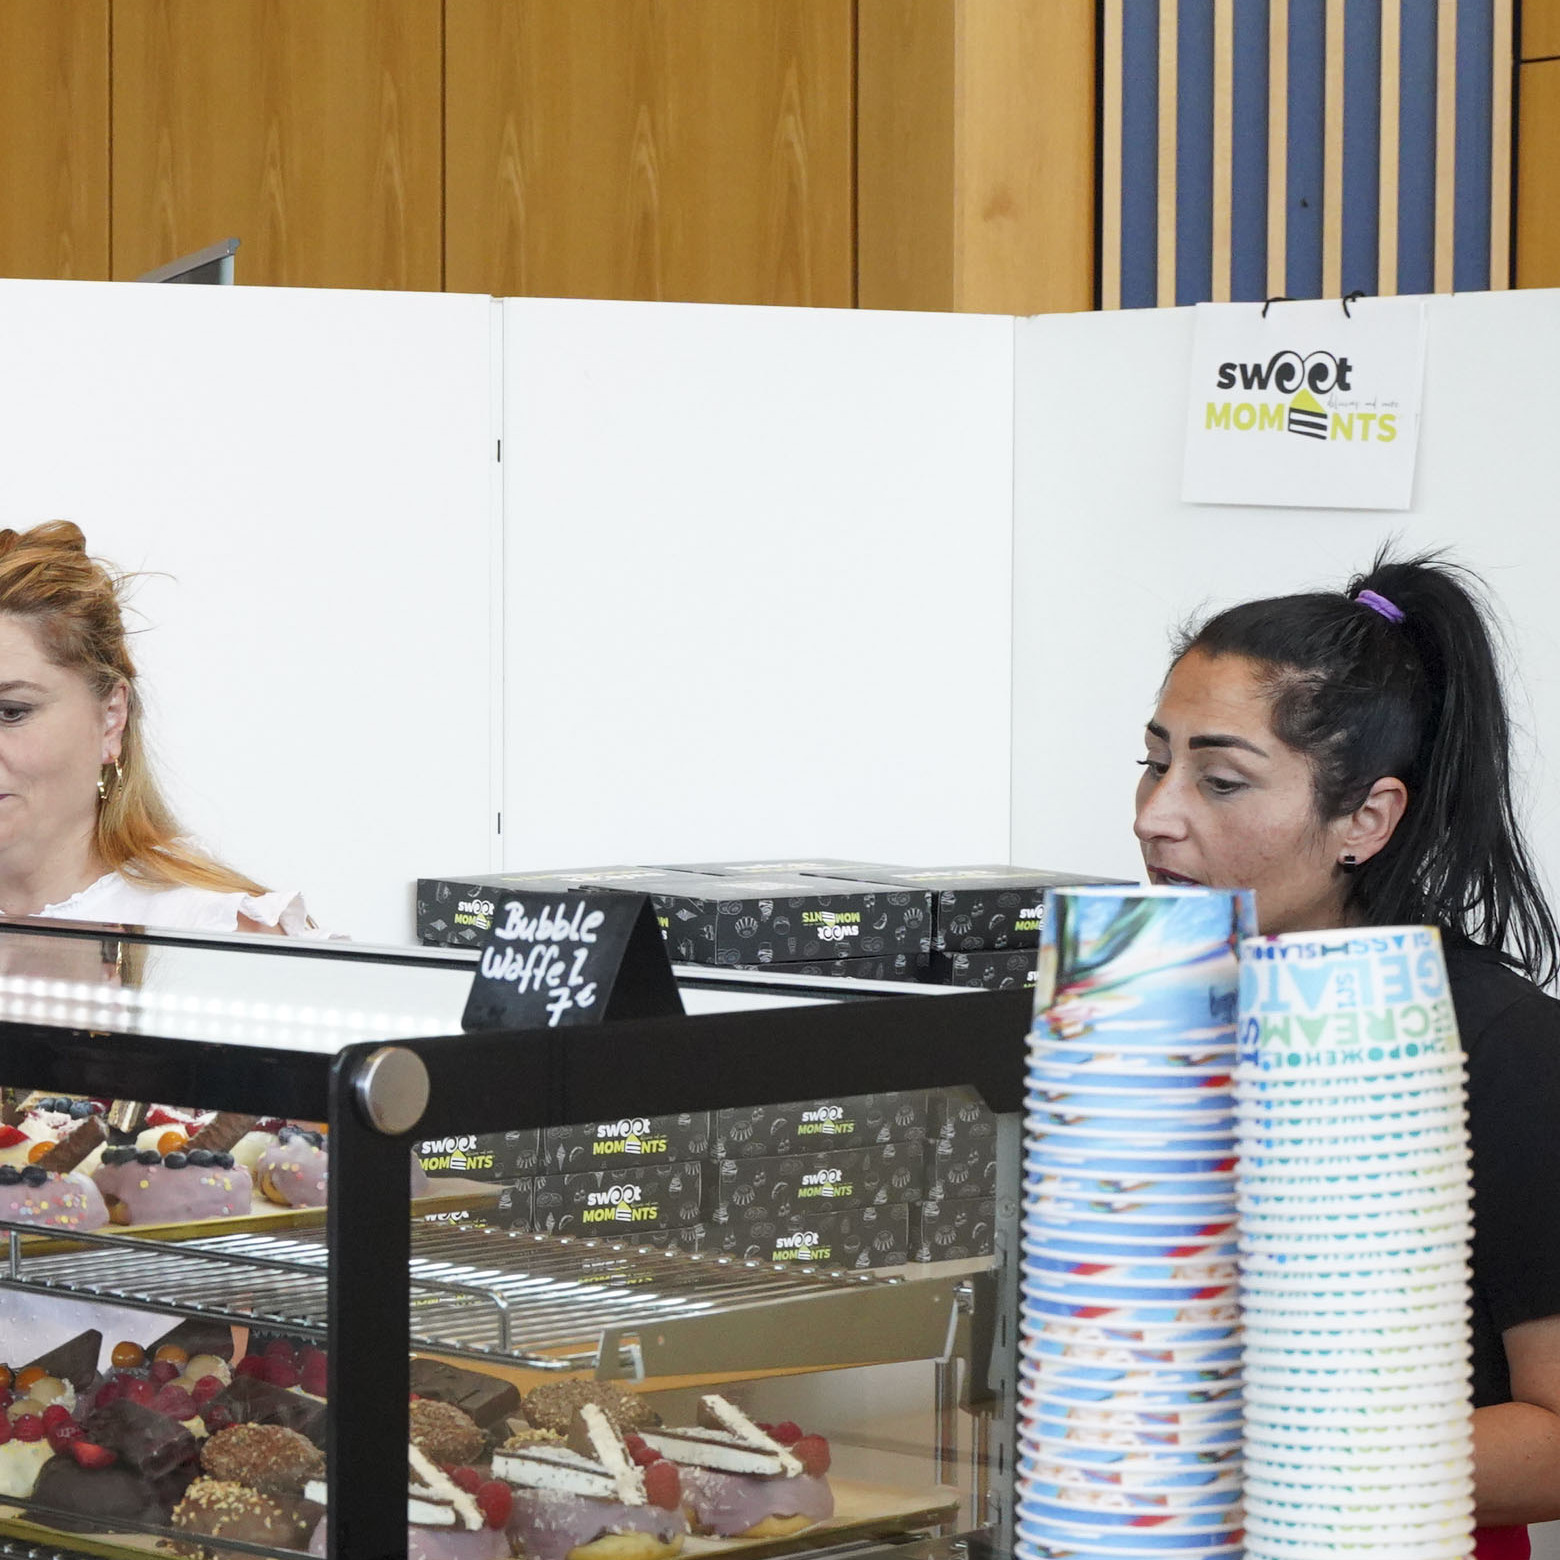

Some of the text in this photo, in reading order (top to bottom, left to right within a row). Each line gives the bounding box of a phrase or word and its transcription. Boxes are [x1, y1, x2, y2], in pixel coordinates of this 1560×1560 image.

[1216, 350, 1353, 394] sweet
[1204, 390, 1398, 442] MOMENTS
[494, 900, 605, 943] Bubble
[802, 1105, 844, 1121] sweet
[597, 1117, 651, 1138] sweet
[798, 1120, 855, 1135] MOMENTS
[421, 1135, 477, 1154] sweet
[592, 1134, 667, 1155] MOMENTS
[802, 1168, 842, 1185] sweet
[587, 1184, 641, 1206] sweet
[798, 1183, 853, 1198] MOMENTS
[583, 1202, 658, 1223] MOMENTS
[776, 1231, 819, 1248] sweet
[772, 1245, 831, 1261] MOMENTS
